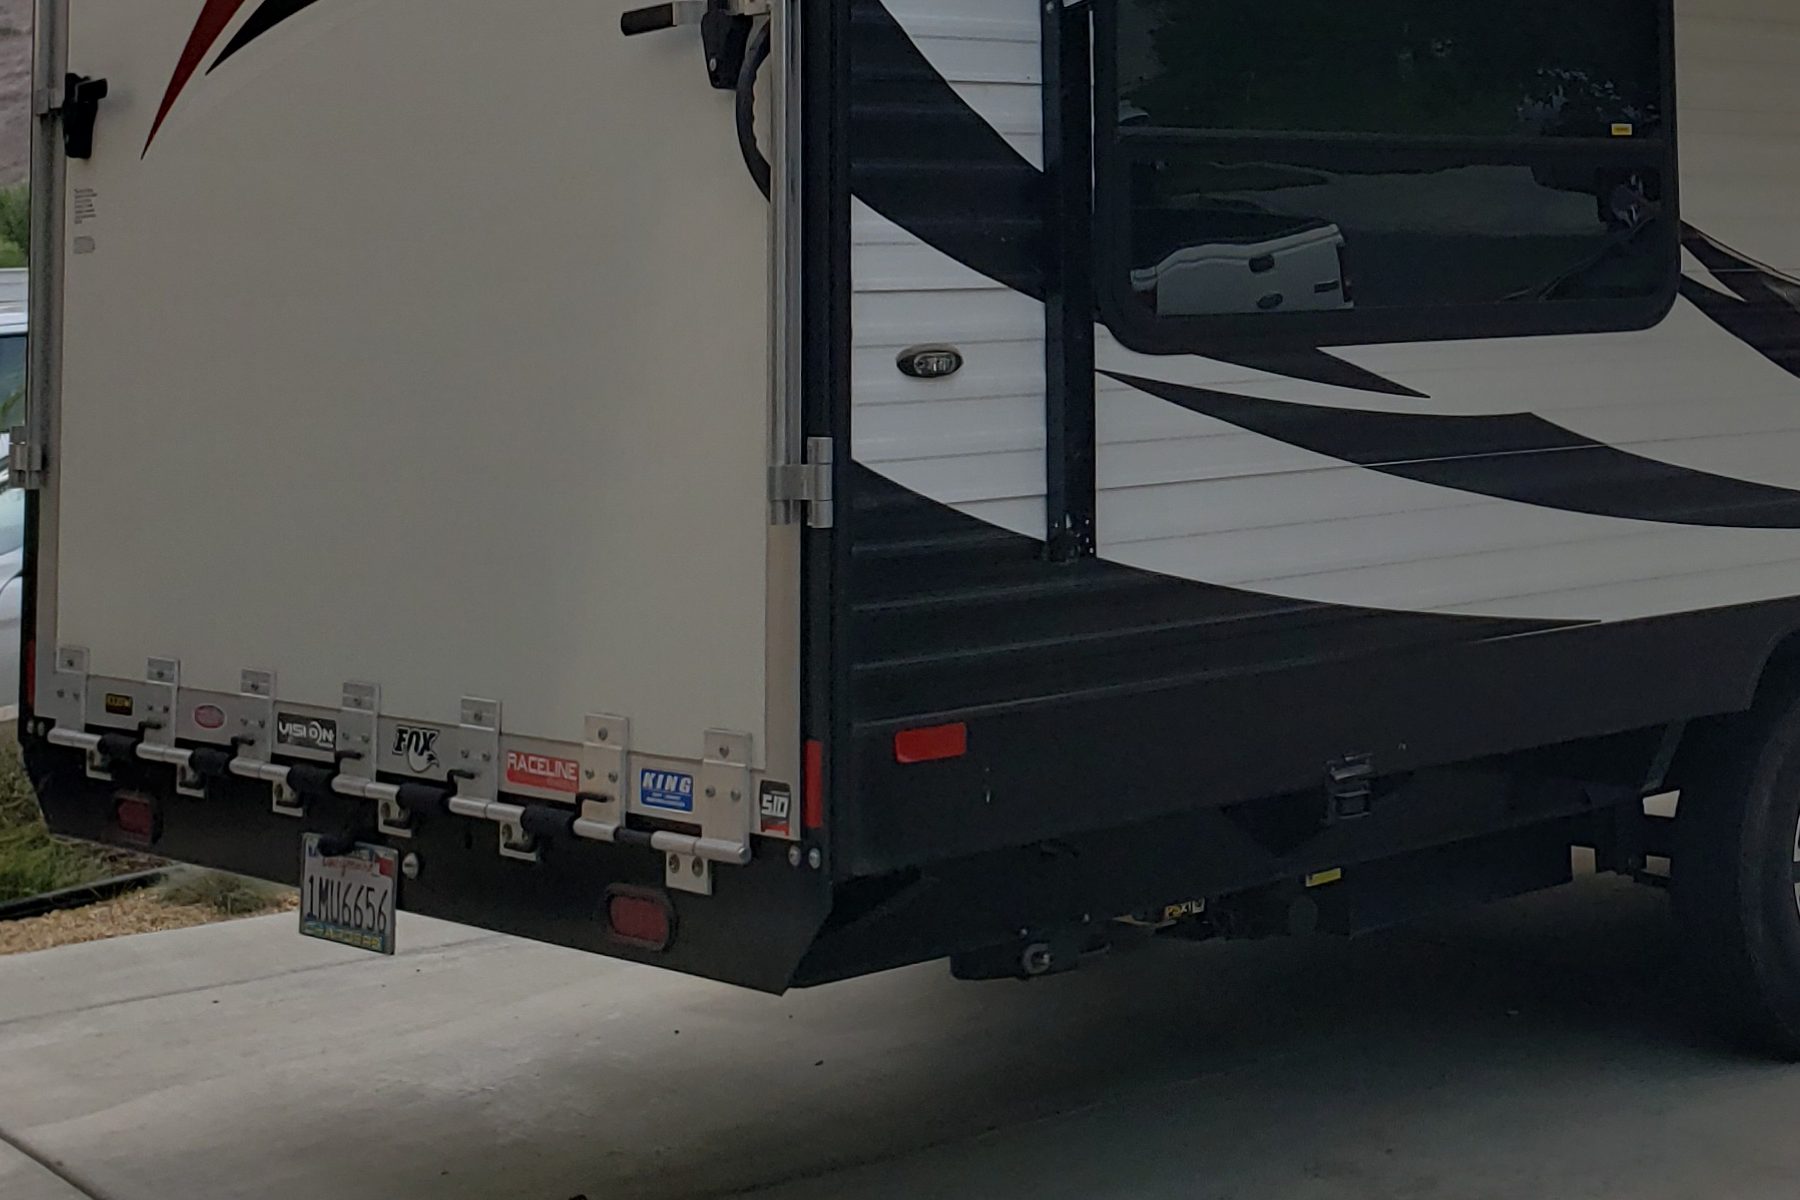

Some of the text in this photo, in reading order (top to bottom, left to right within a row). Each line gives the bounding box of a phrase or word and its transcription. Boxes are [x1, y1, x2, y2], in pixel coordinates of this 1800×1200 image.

[279, 721, 335, 743] VISION
[392, 724, 440, 758] FOX
[507, 752, 578, 781] RACELINE
[643, 772, 691, 794] KING
[306, 874, 389, 934] 1MU6656
